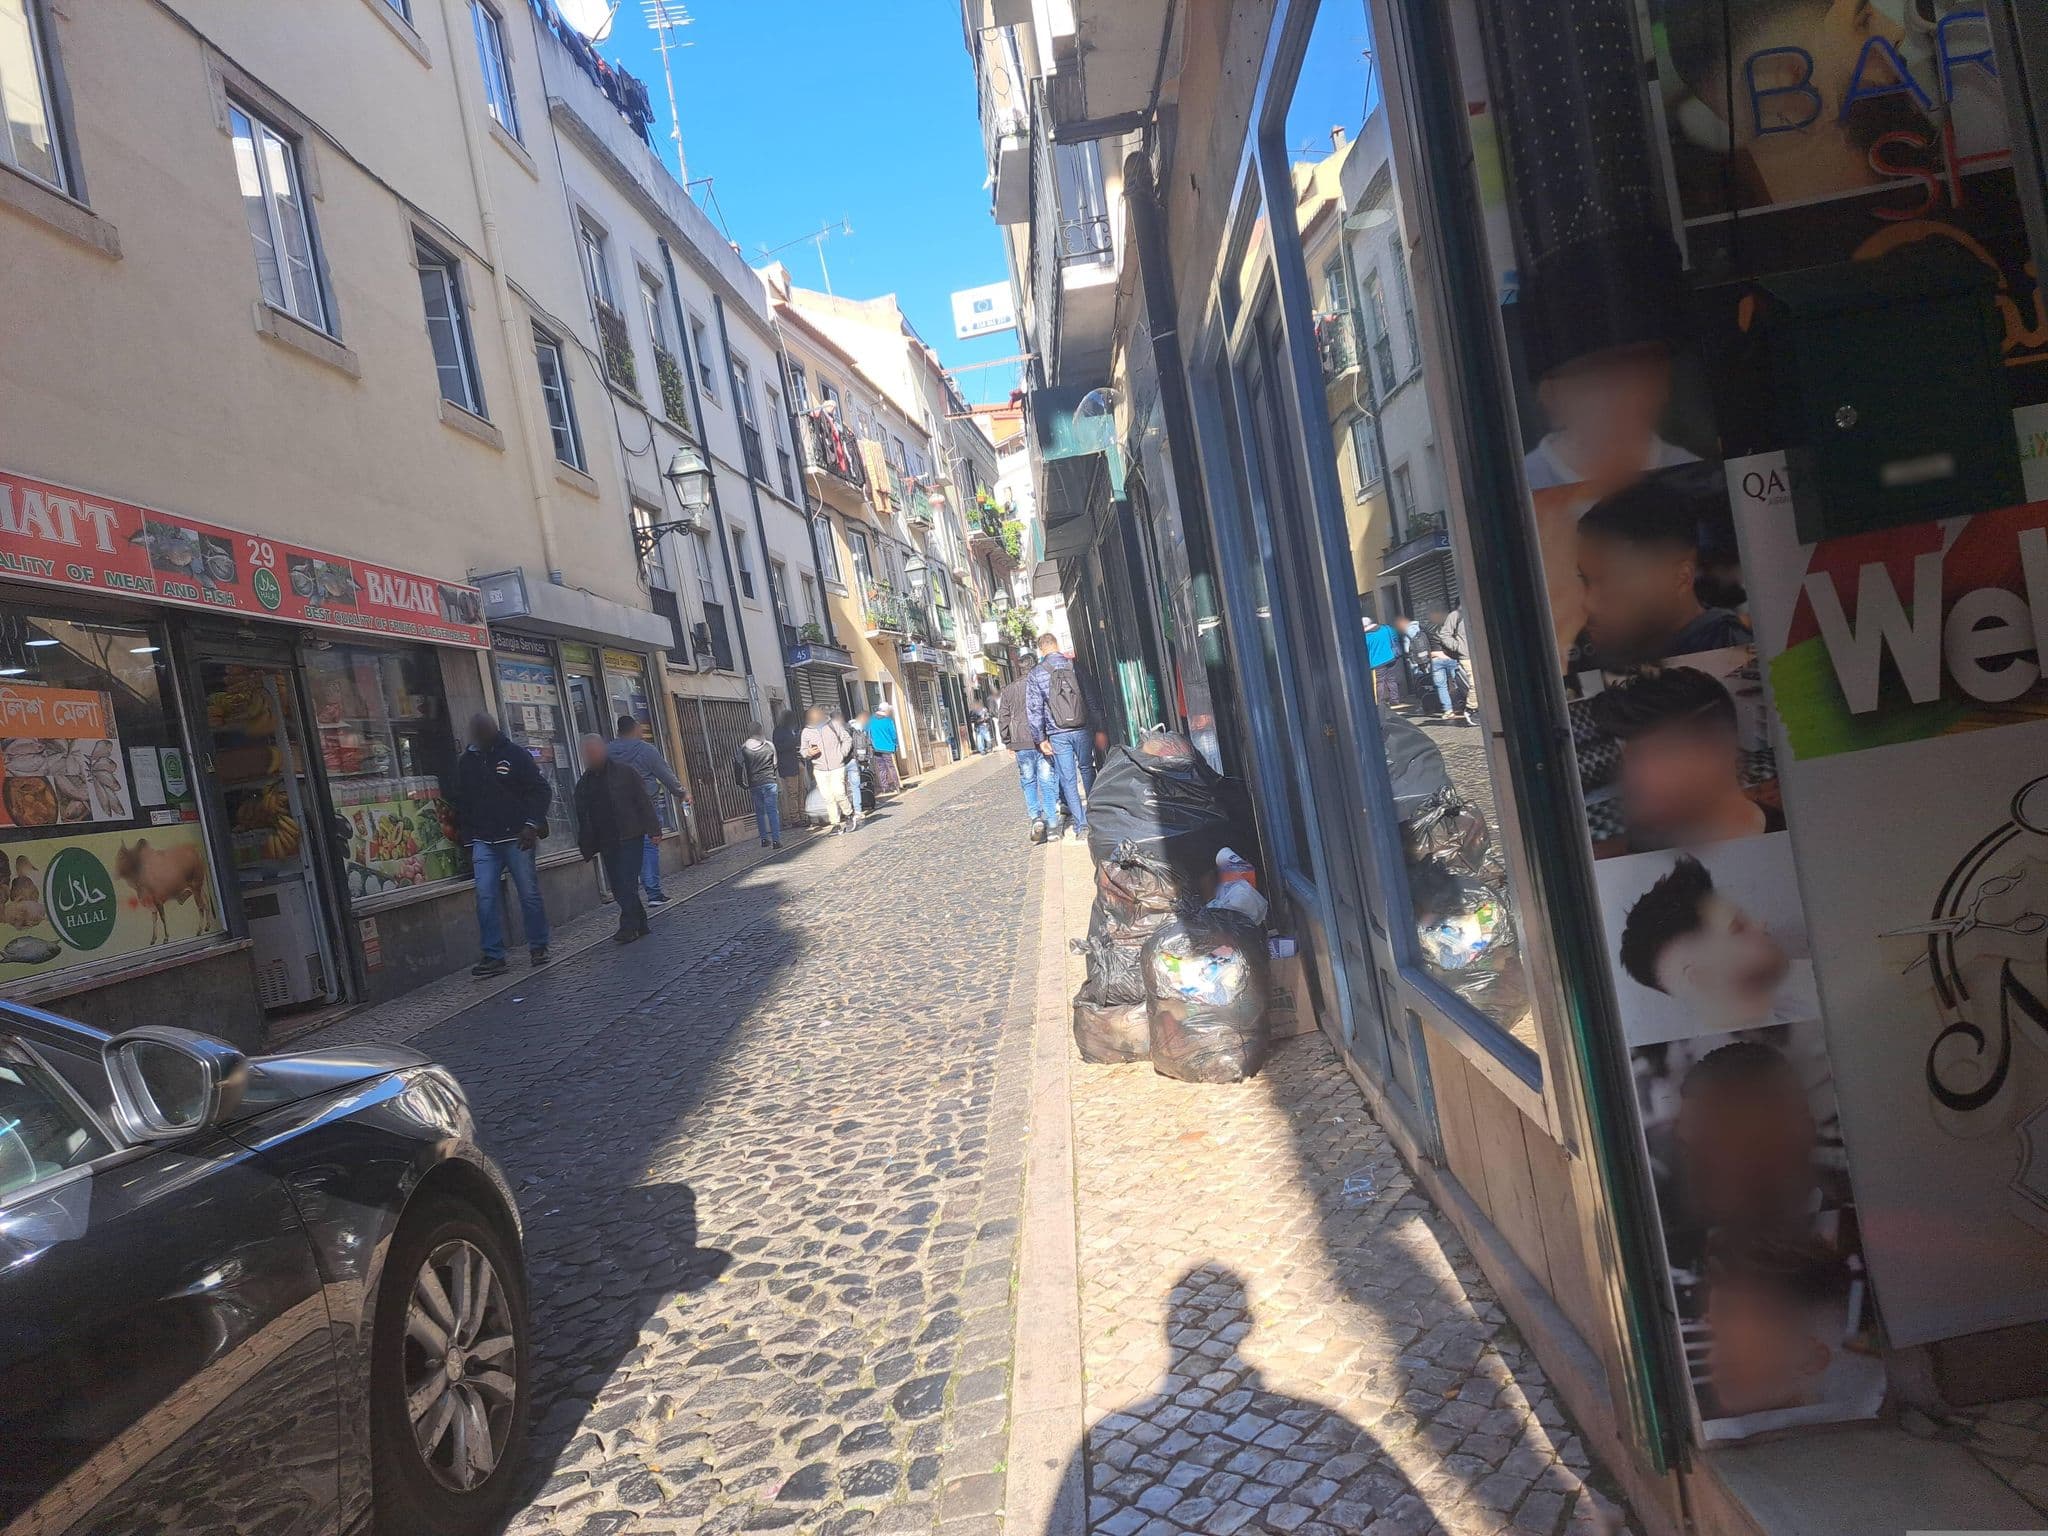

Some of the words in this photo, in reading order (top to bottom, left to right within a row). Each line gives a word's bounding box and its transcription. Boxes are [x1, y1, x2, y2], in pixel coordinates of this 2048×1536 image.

[247, 539, 274, 568] 29
[66, 564, 95, 582] OF
[104, 571, 156, 592] MEAT
[162, 580, 200, 601] AND
[201, 586, 237, 607] FISH
[365, 570, 439, 616] BAZAR
[304, 605, 331, 622] BEST
[797, 650, 807, 660] 45
[59, 873, 106, 911] حلال
[66, 910, 107, 928] HALAL
